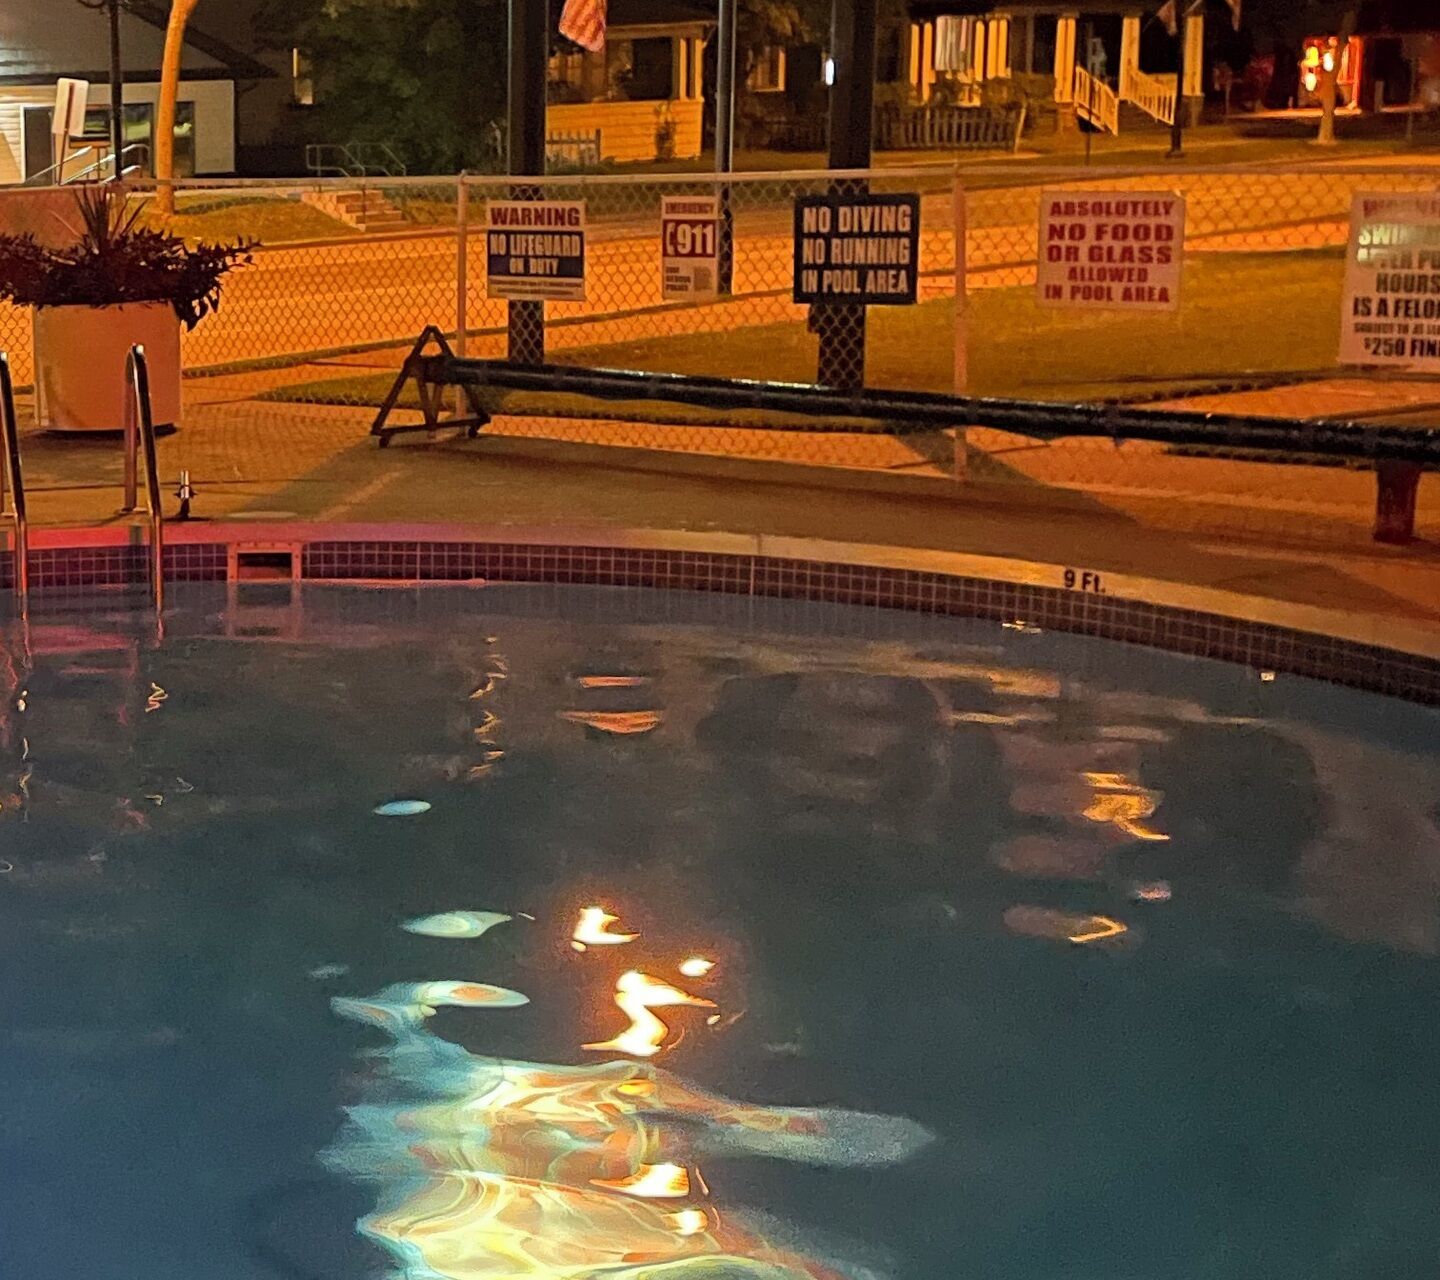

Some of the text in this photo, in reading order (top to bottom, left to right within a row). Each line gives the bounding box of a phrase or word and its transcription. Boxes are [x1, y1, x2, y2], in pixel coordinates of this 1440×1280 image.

[490, 207, 580, 226] WARNING
[803, 204, 911, 233] NO DIVING
[1050, 200, 1175, 217] ABSOLUTELY
[676, 223, 714, 254] 911
[1047, 223, 1174, 242] NO FOOD
[489, 233, 580, 257] NO LIFEGUARD
[802, 237, 910, 265] NO RUNNING
[1047, 244, 1173, 264] OR GLASS
[529, 257, 559, 275] DUTY
[1067, 266, 1149, 283] ALLOWED
[802, 269, 909, 293] IN POOL AREA
[1376, 272, 1440, 294] HOURS
[1045, 284, 1170, 303] IN POOL AREA
[1353, 296, 1372, 317] IS
[1376, 297, 1389, 317] A
[1363, 336, 1406, 357] $250
[1064, 569, 1076, 588] 9
